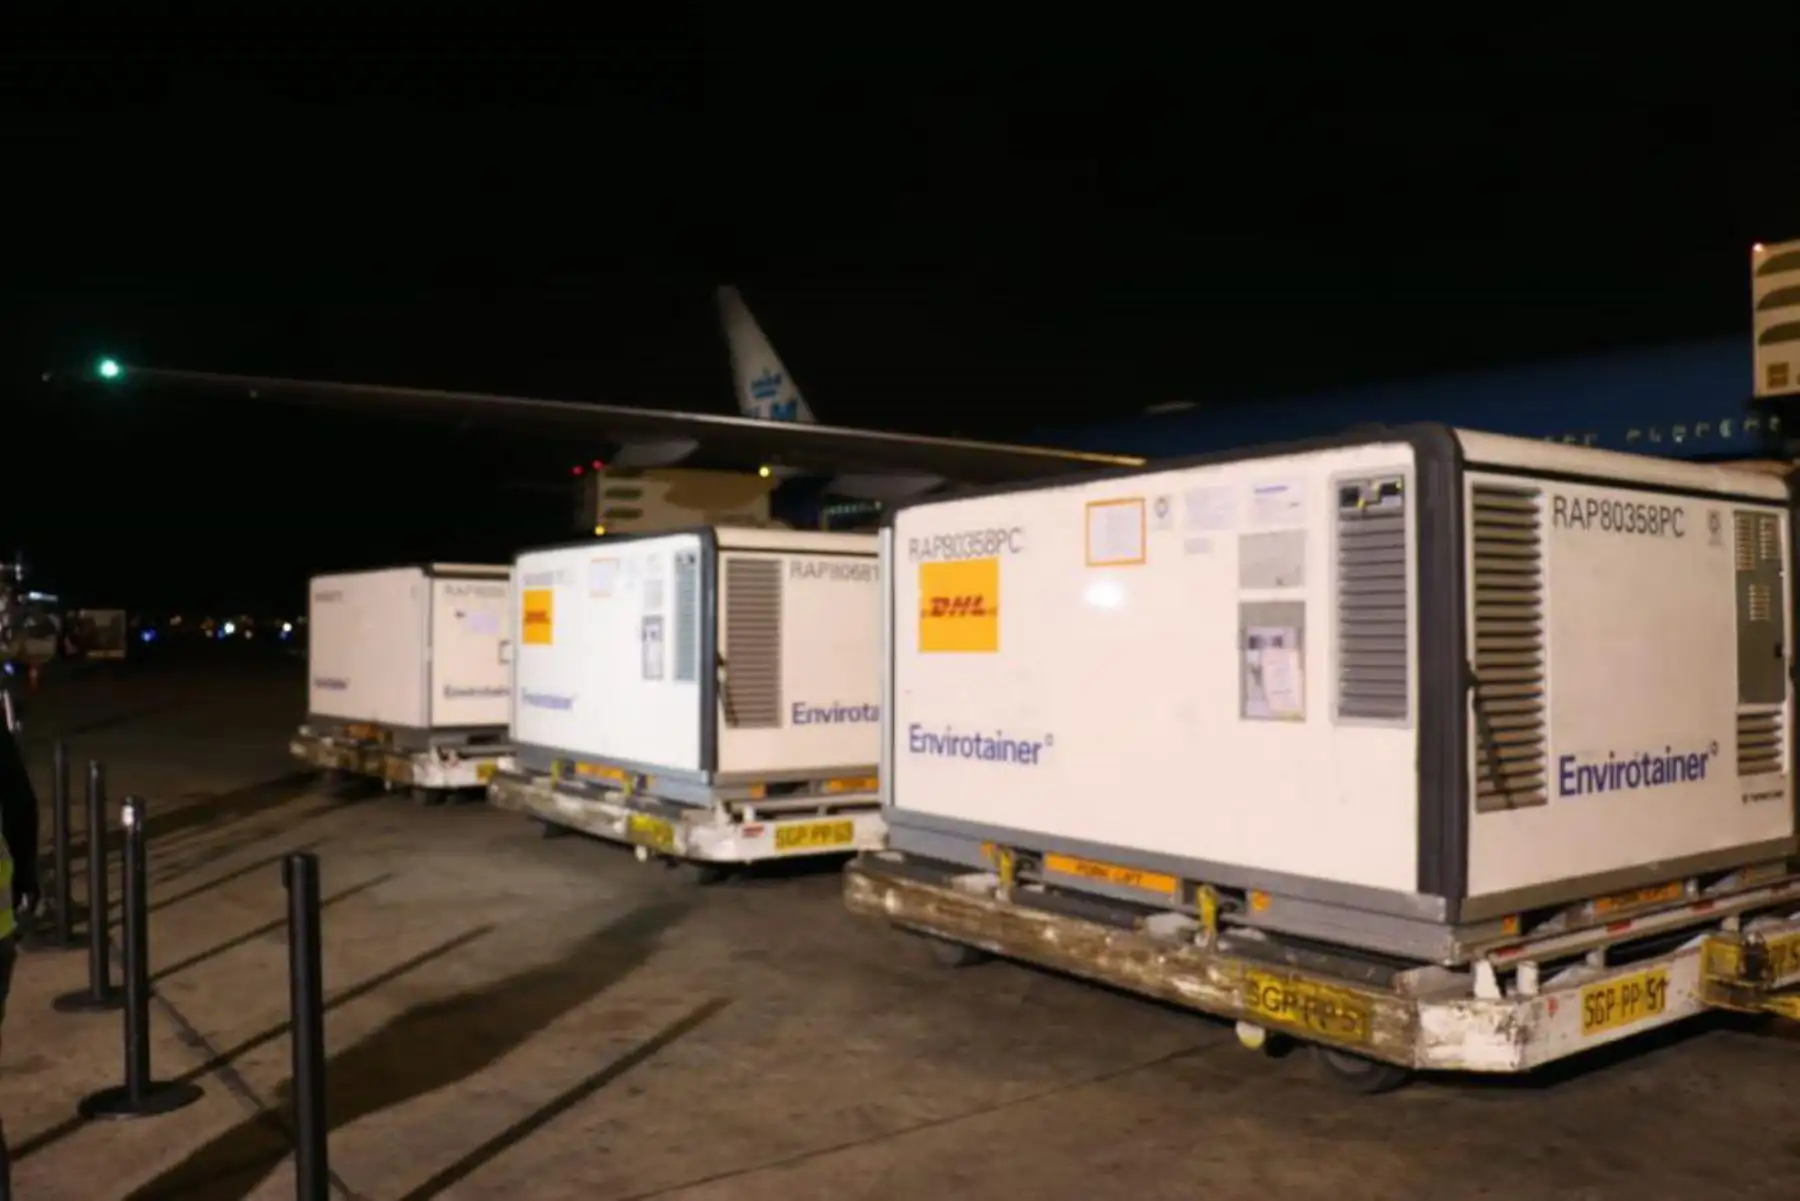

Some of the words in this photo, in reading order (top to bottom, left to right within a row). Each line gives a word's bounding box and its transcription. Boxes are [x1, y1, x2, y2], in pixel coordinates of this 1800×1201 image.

[1553, 496, 1685, 538] RAP80358PC
[930, 595, 985, 617] DHL
[908, 721, 1043, 766] Envirotainer
[1558, 744, 1709, 797] Envirotainer
[1584, 987, 1616, 1028] SGP
[1622, 980, 1641, 1018] PP
